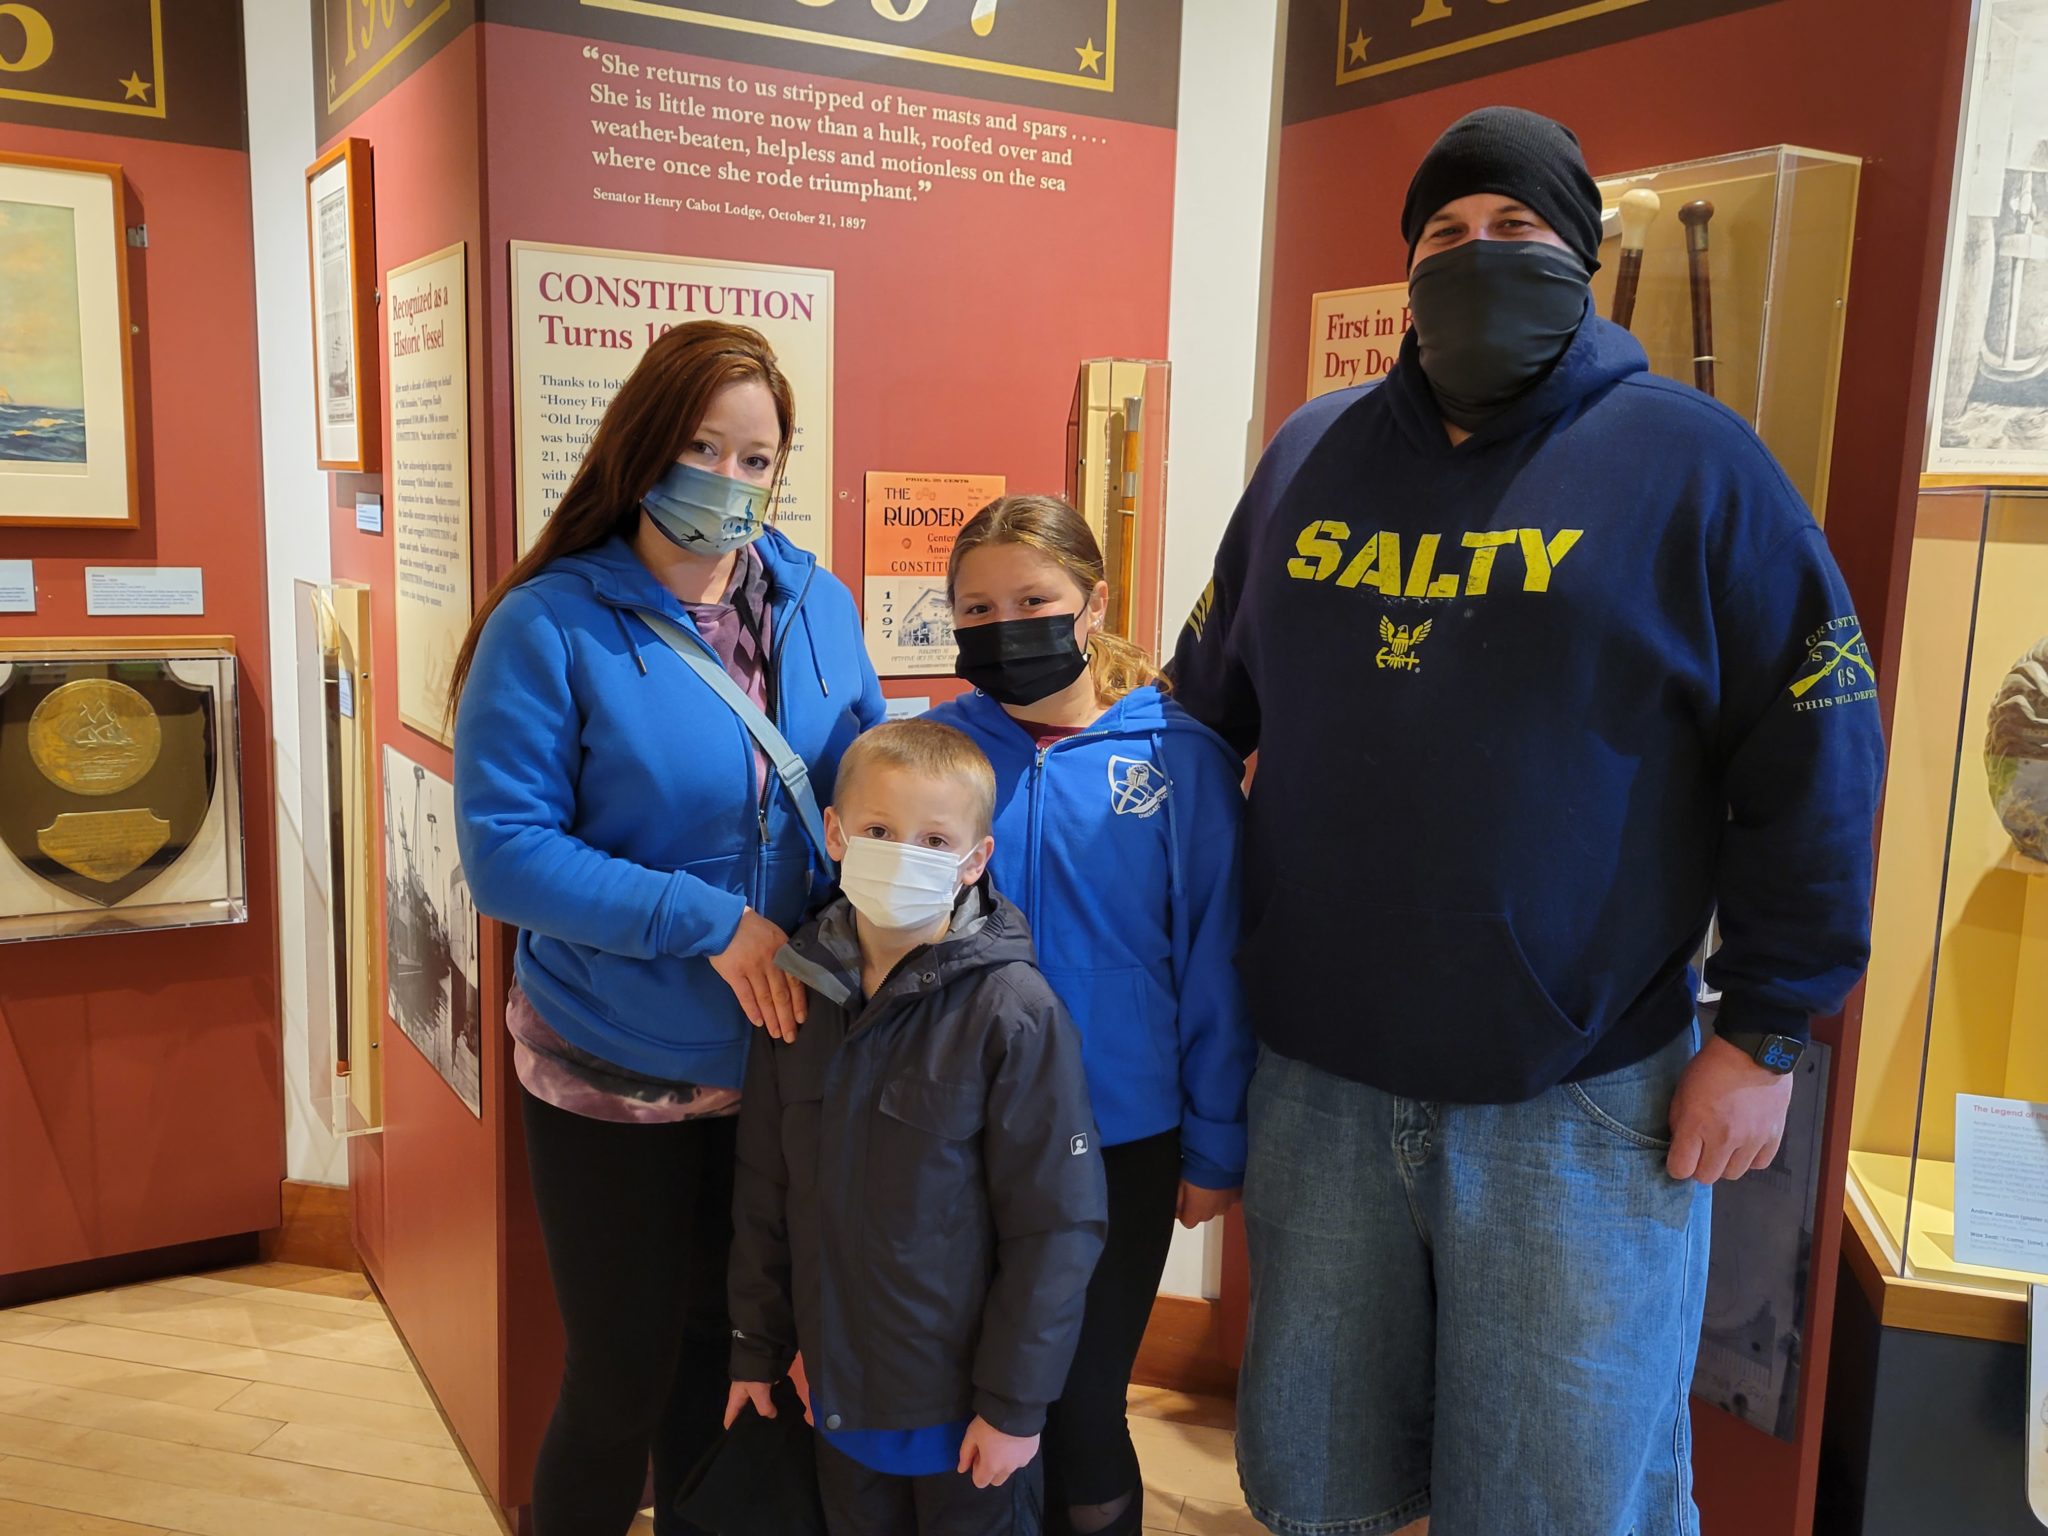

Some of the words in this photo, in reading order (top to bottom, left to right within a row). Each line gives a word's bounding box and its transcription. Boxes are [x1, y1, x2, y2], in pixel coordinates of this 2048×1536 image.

[646, 65, 722, 90] returns
[727, 75, 748, 93] to
[754, 81, 777, 97] us
[782, 83, 865, 112] stripped
[870, 95, 892, 113] of
[896, 96, 927, 118] her
[931, 106, 981, 126] masts
[985, 113, 1017, 131] and
[1022, 119, 1068, 140] spars
[590, 82, 629, 107] She
[635, 88, 652, 110] is
[658, 92, 706, 117] little
[711, 105, 765, 126] more
[770, 113, 812, 131] now
[817, 115, 858, 138] than
[863, 128, 874, 140] a
[878, 122, 926, 150] hulk,
[931, 134, 993, 155] roofed
[998, 143, 1038, 161] over
[1041, 148, 1073, 166] and
[590, 119, 751, 155] weather-beaten,
[756, 135, 836, 165] helpless
[840, 150, 875, 168] and
[880, 156, 977, 180] motionless
[982, 168, 1005, 184] on
[1009, 167, 1036, 187] the
[1040, 177, 1066, 192] sea
[592, 146, 656, 172] where
[662, 159, 712, 178] once
[717, 161, 751, 183] she
[756, 168, 804, 189] rode
[593, 187, 642, 205] Senator
[644, 192, 683, 212] Henry
[686, 198, 721, 213] Cabot
[724, 202, 766, 220] Lodge,
[768, 207, 816, 224] October
[818, 213, 836, 228] 21,
[839, 215, 867, 230] 1897
[392, 282, 432, 326] Recognized
[434, 287, 442, 308] as
[443, 286, 448, 306] a
[538, 271, 815, 323] CONSTITUTION
[393, 326, 420, 357] Historic
[421, 318, 444, 351] Vessel
[538, 314, 633, 351] Turns
[1326, 313, 1370, 341] First
[1374, 309, 1394, 336] in
[539, 374, 585, 389] Thanks
[588, 379, 600, 389] to
[1324, 351, 1361, 387] Dry
[541, 433, 563, 443] was
[541, 450, 560, 463] 21,
[541, 469, 567, 481] with
[884, 487, 911, 501] THE
[883, 506, 965, 527] RUDDER
[1286, 519, 1584, 598] SALTY
[1793, 698, 1833, 712] THIS
[1973, 1104, 1988, 1113] The
[1990, 1106, 2023, 1117] Legend
